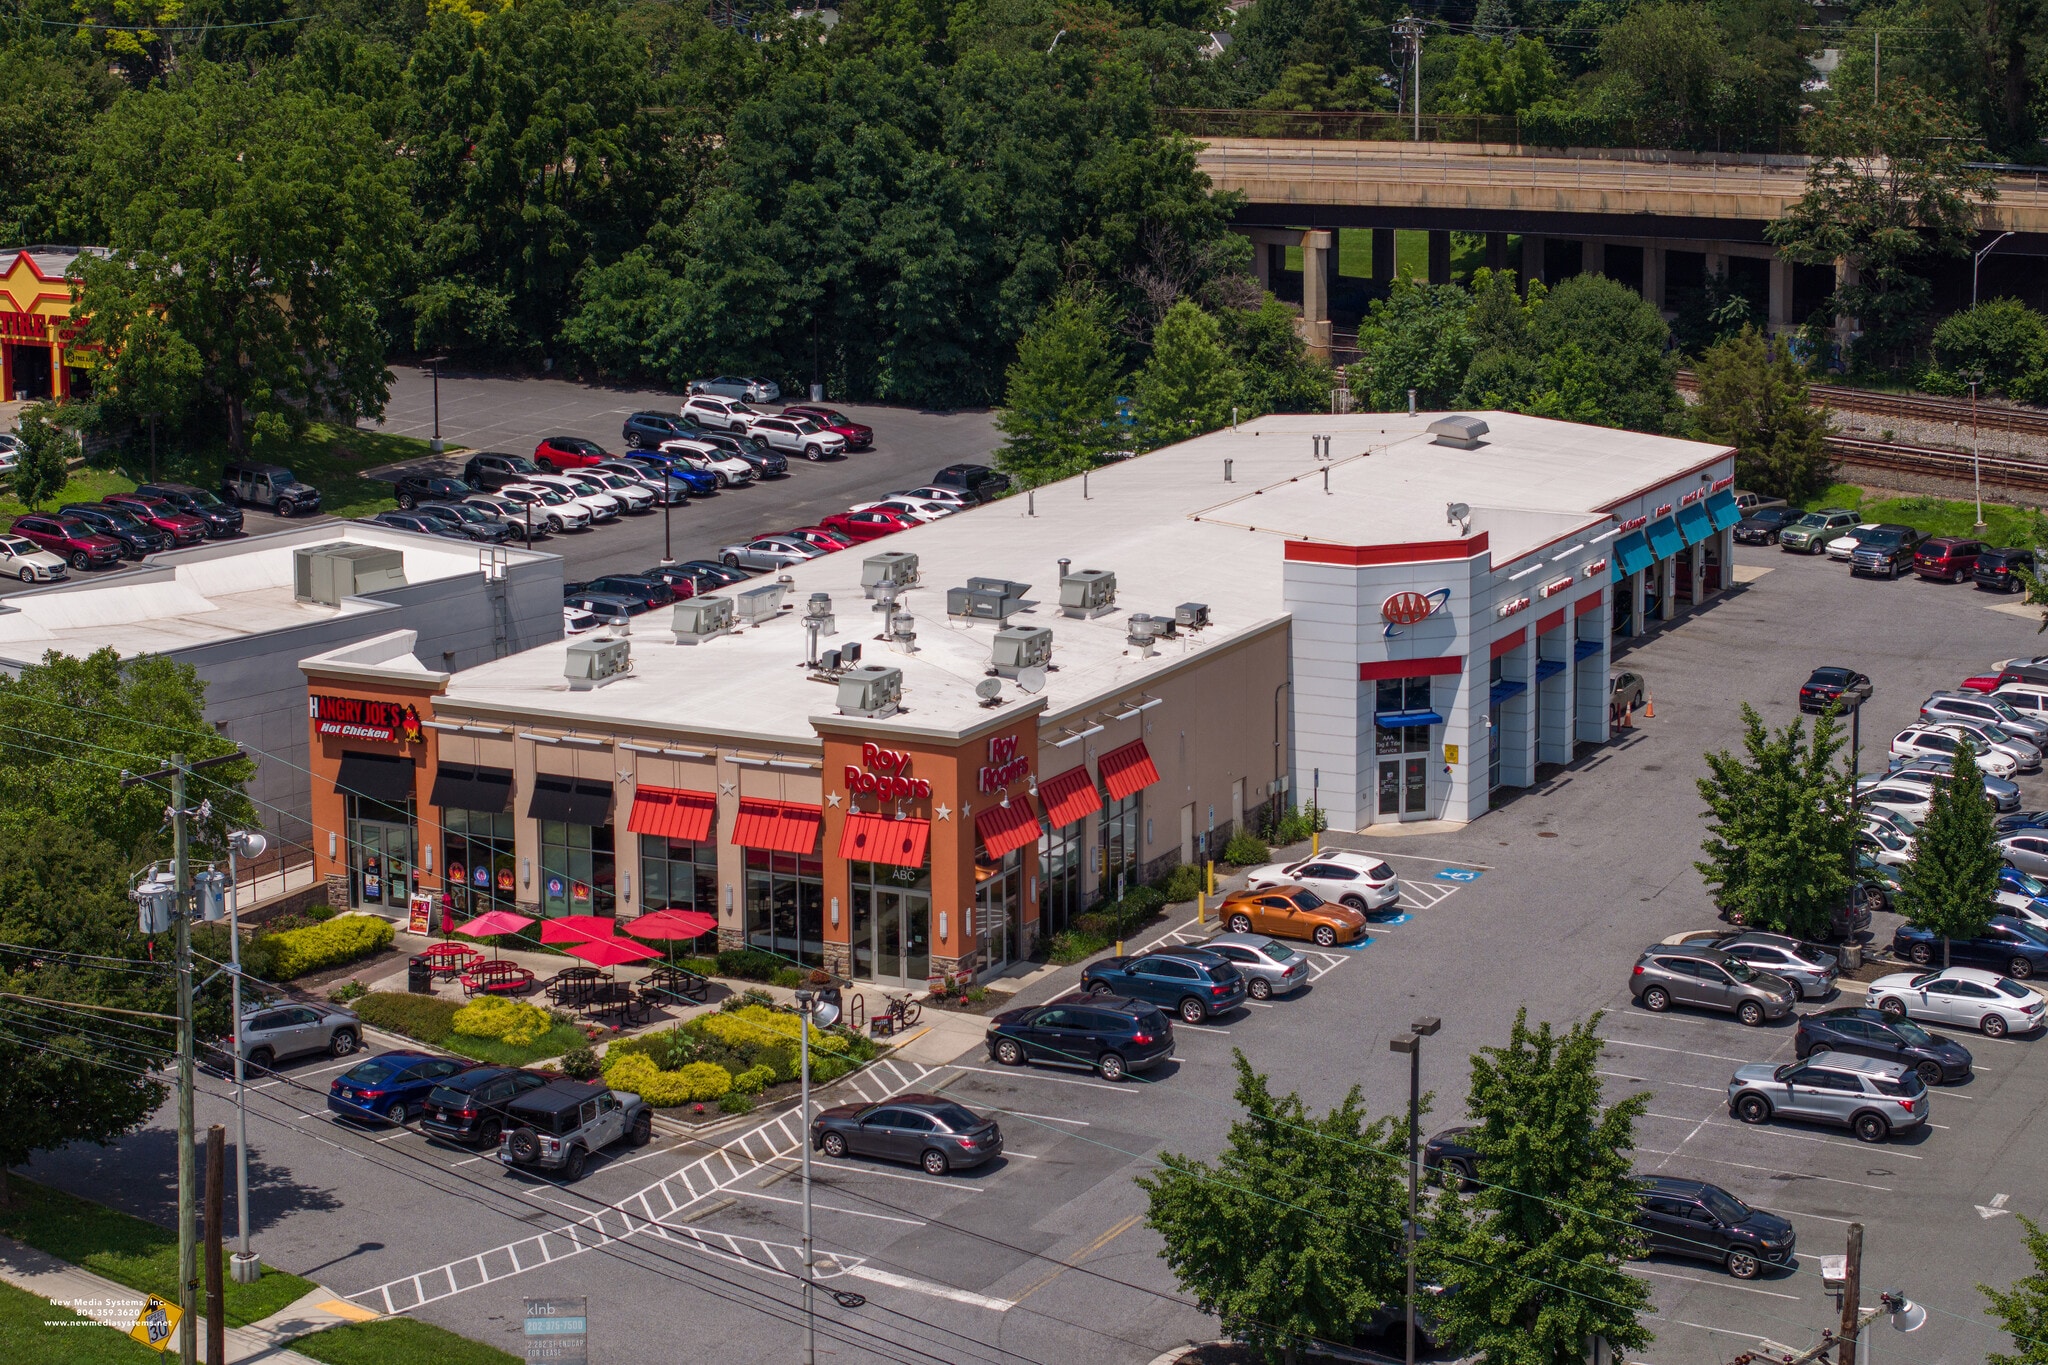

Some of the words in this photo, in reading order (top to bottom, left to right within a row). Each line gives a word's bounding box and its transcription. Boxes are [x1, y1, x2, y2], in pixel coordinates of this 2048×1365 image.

[0, 311, 46, 338] TIRE
[1385, 593, 1429, 623] AAA
[309, 696, 362, 722] HANGRY
[364, 702, 400, 727] JOE'S
[320, 722, 341, 733] Hot
[342, 725, 389, 739] Chicken
[862, 742, 911, 777] Roy
[988, 735, 1018, 763] Roy
[844, 765, 931, 802] Rogers
[979, 756, 1029, 793] Rogers
[892, 869, 915, 881] ABC
[527, 1303, 556, 1315] klnb
[149, 1320, 168, 1341] 30
[527, 1349, 541, 1357] FOR
[542, 1348, 562, 1357] LEASE
